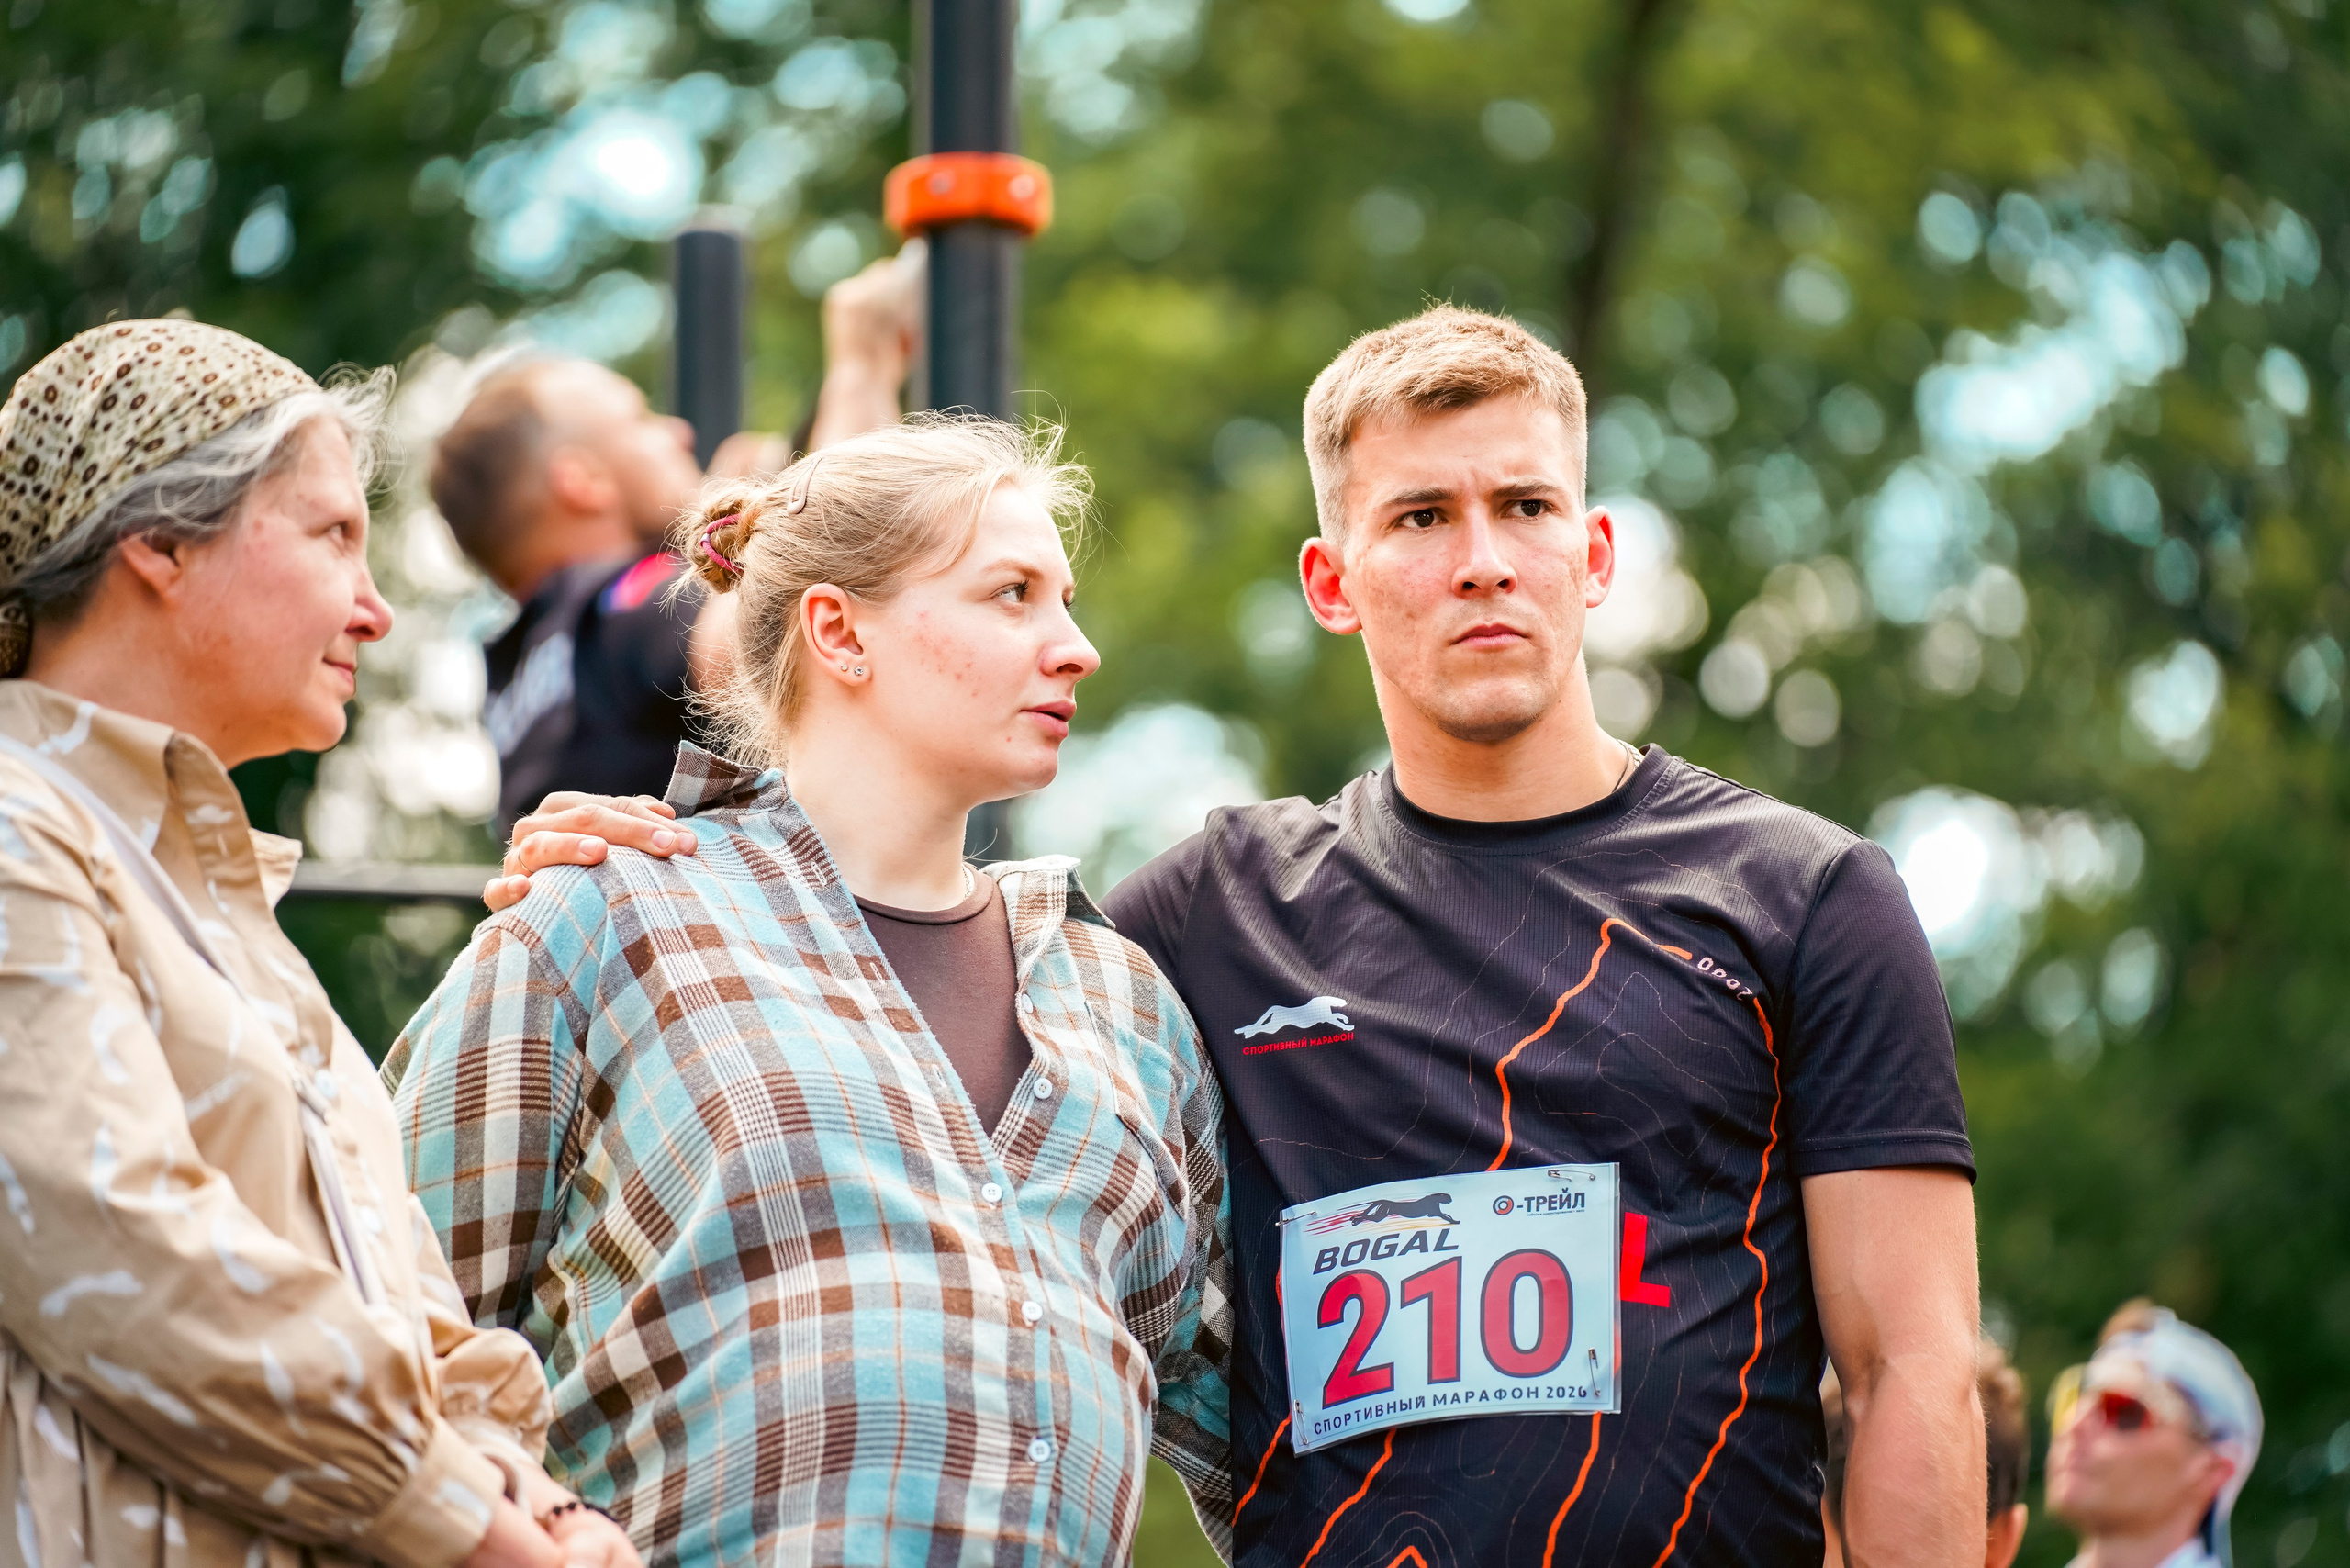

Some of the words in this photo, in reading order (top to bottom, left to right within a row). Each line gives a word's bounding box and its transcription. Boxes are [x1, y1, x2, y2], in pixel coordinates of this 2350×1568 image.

[1242, 1037, 1307, 1056] СПОРТИВНЫЙ
[1310, 1032, 1354, 1047] МАРАФОН
[1313, 1227, 1460, 1275] BOGAL
[1316, 1248, 1574, 1409] 210
[1314, 1394, 1427, 1436] СПОРТИВНЫЙ
[1433, 1386, 1539, 1407] МАРАФОН
[1546, 1385, 1587, 1399] 2026
